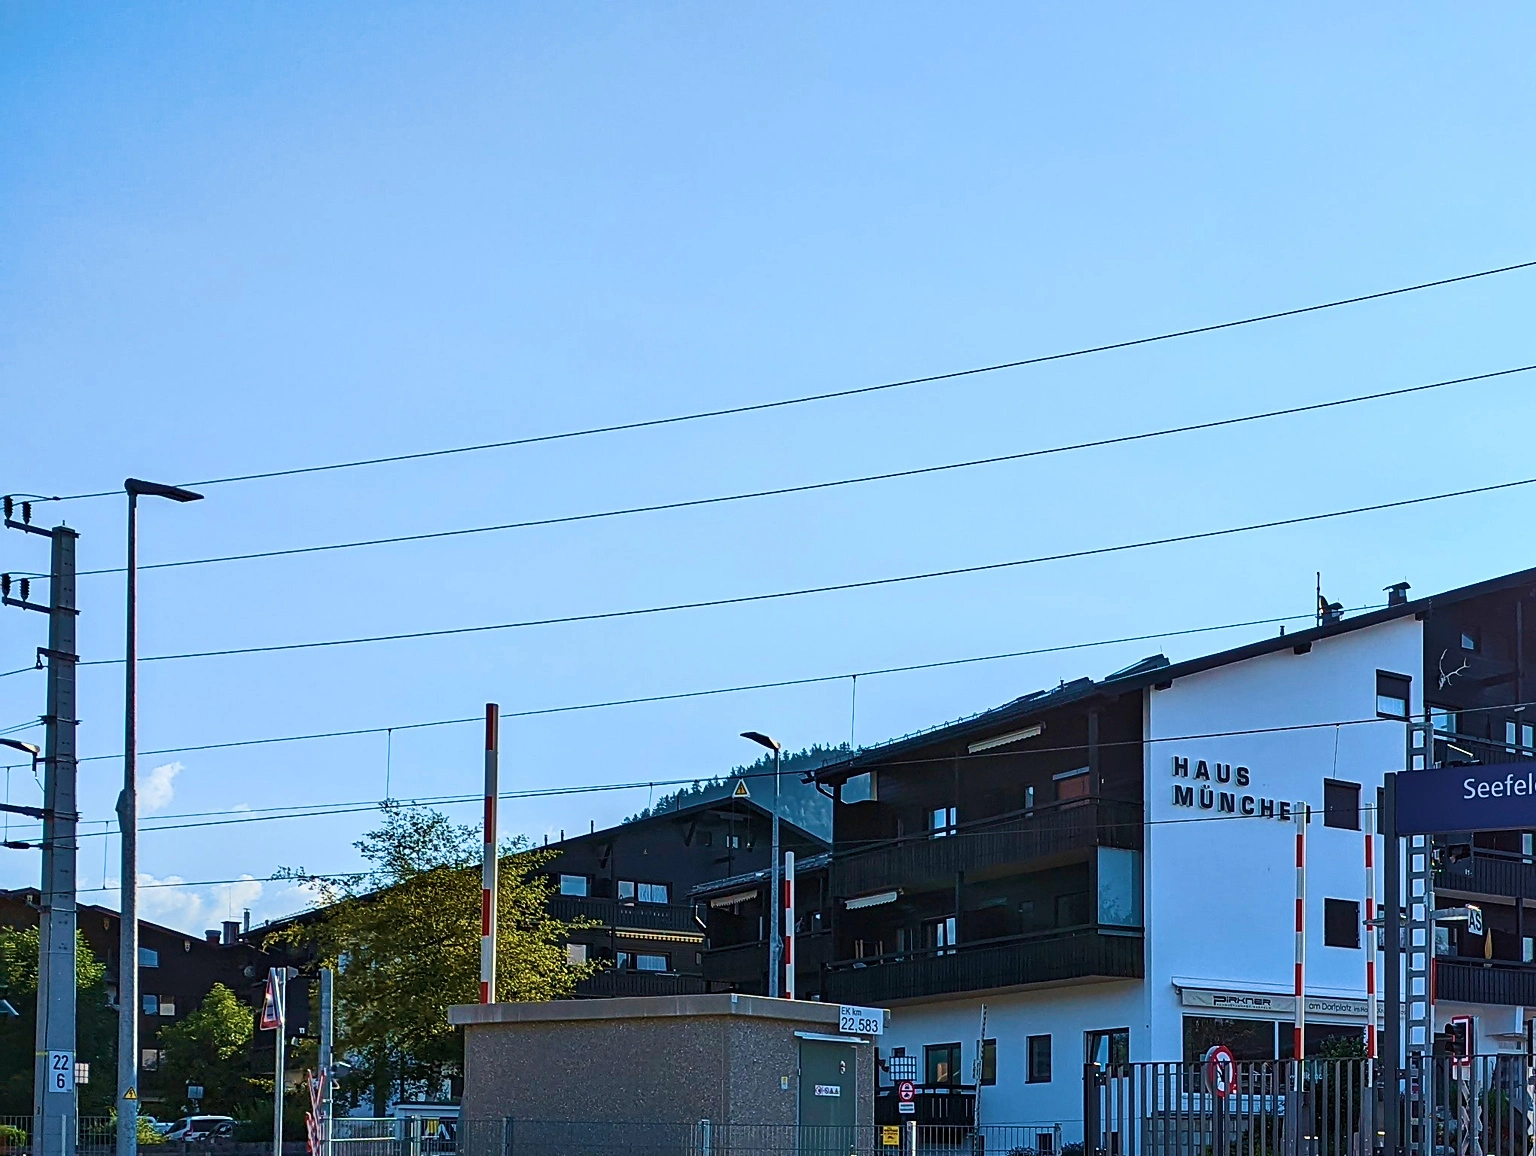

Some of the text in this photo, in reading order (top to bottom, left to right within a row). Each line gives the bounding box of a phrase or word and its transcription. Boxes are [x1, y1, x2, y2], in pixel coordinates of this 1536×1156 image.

[1172, 755, 1250, 786] HAUS
[1469, 909, 1482, 932] AS
[841, 1007, 862, 1016] EK km
[1308, 1002, 1321, 1010] am
[1322, 1002, 1352, 1012] Dorfplatz
[841, 1017, 878, 1033] 22,583
[53, 1055, 69, 1071] 22
[56, 1073, 66, 1089] 6
